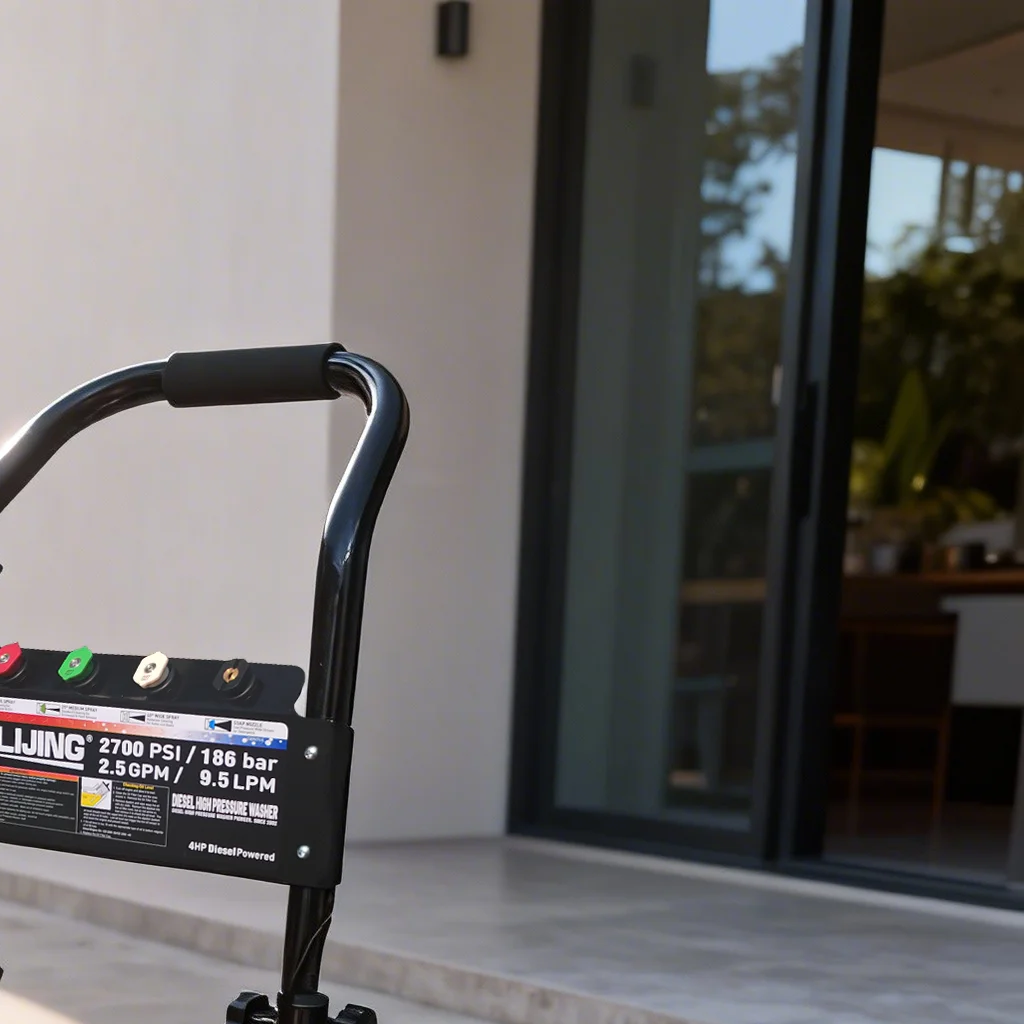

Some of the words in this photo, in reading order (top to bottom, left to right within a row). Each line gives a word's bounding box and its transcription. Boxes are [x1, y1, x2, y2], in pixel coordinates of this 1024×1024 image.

[98, 737, 144, 757] 2700
[149, 742, 181, 762] PSI
[200, 748, 236, 768] 186
[242, 752, 278, 772] bar
[171, 792, 195, 810] DIESEL
[195, 795, 212, 812] HIGH
[212, 798, 248, 817] PRESSURE
[248, 802, 279, 820] WASHER
[188, 841, 207, 852] 4HP
[236, 847, 275, 862] Powered
